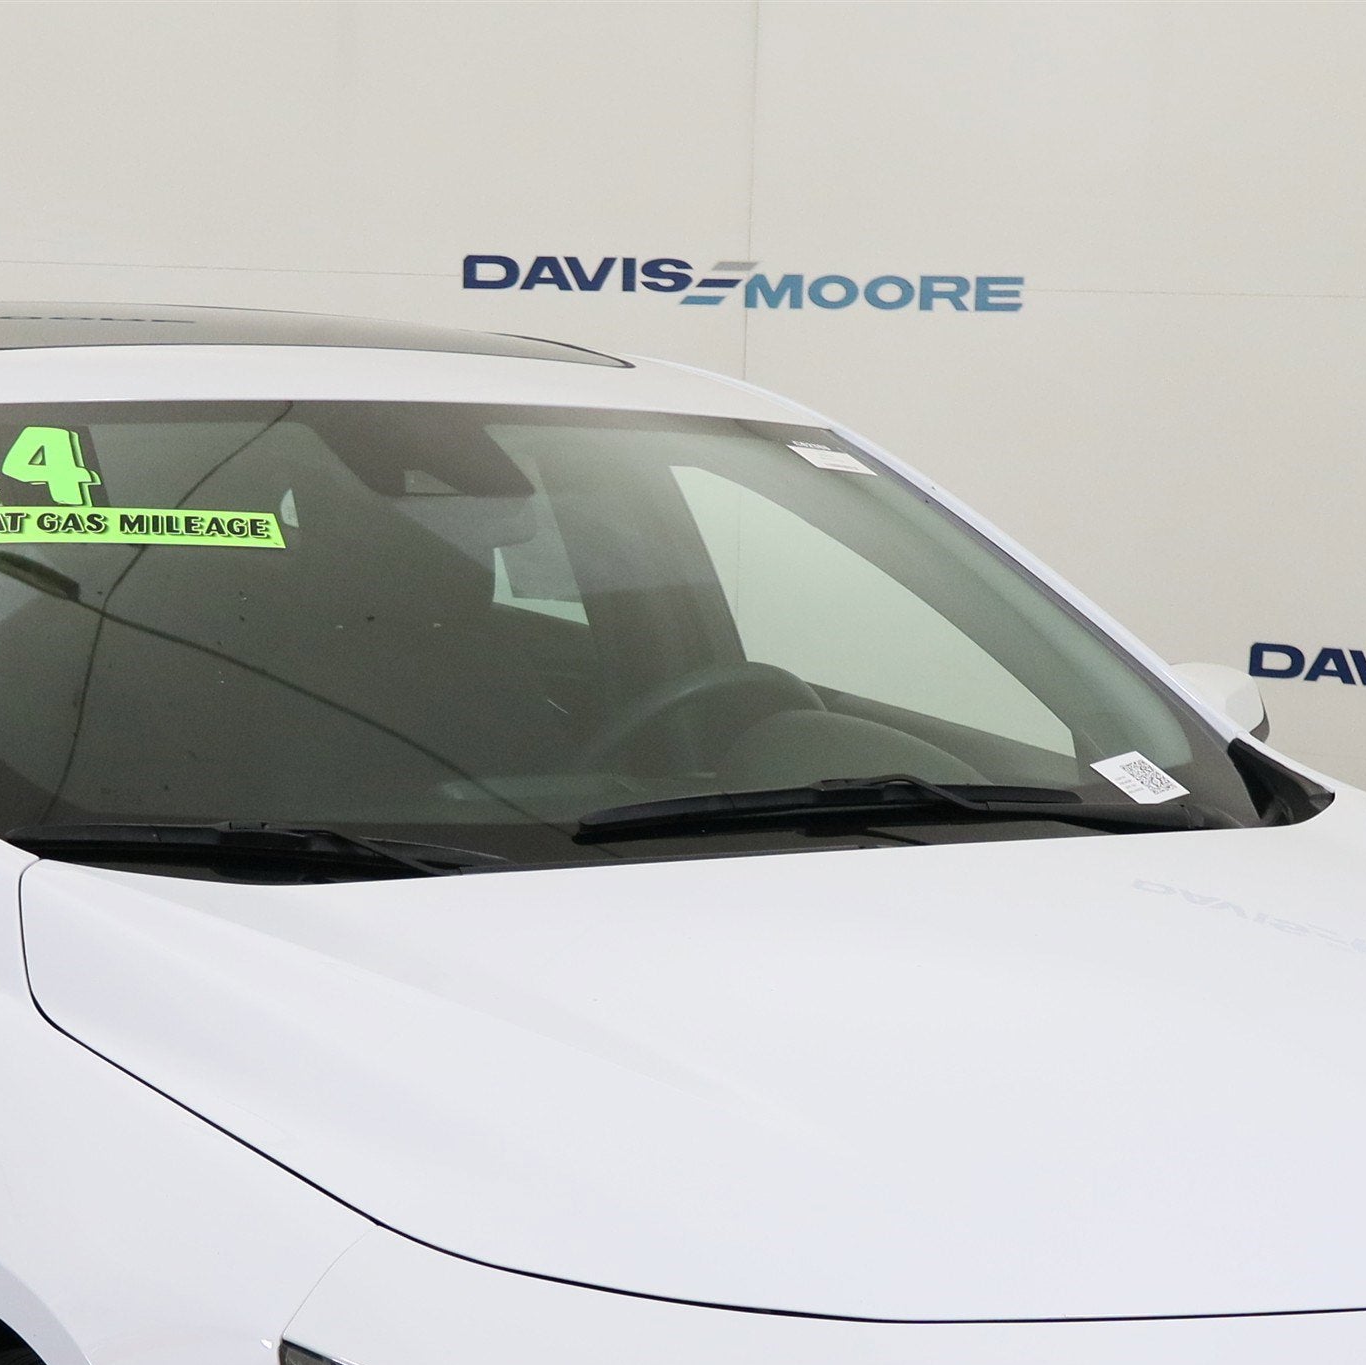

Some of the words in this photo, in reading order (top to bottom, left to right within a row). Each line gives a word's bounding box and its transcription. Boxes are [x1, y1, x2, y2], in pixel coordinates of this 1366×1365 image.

[462, 254, 694, 293] DAVIS
[744, 273, 1024, 312] MOORE
[36, 512, 109, 534] GAS
[119, 513, 272, 540] MILEAGE
